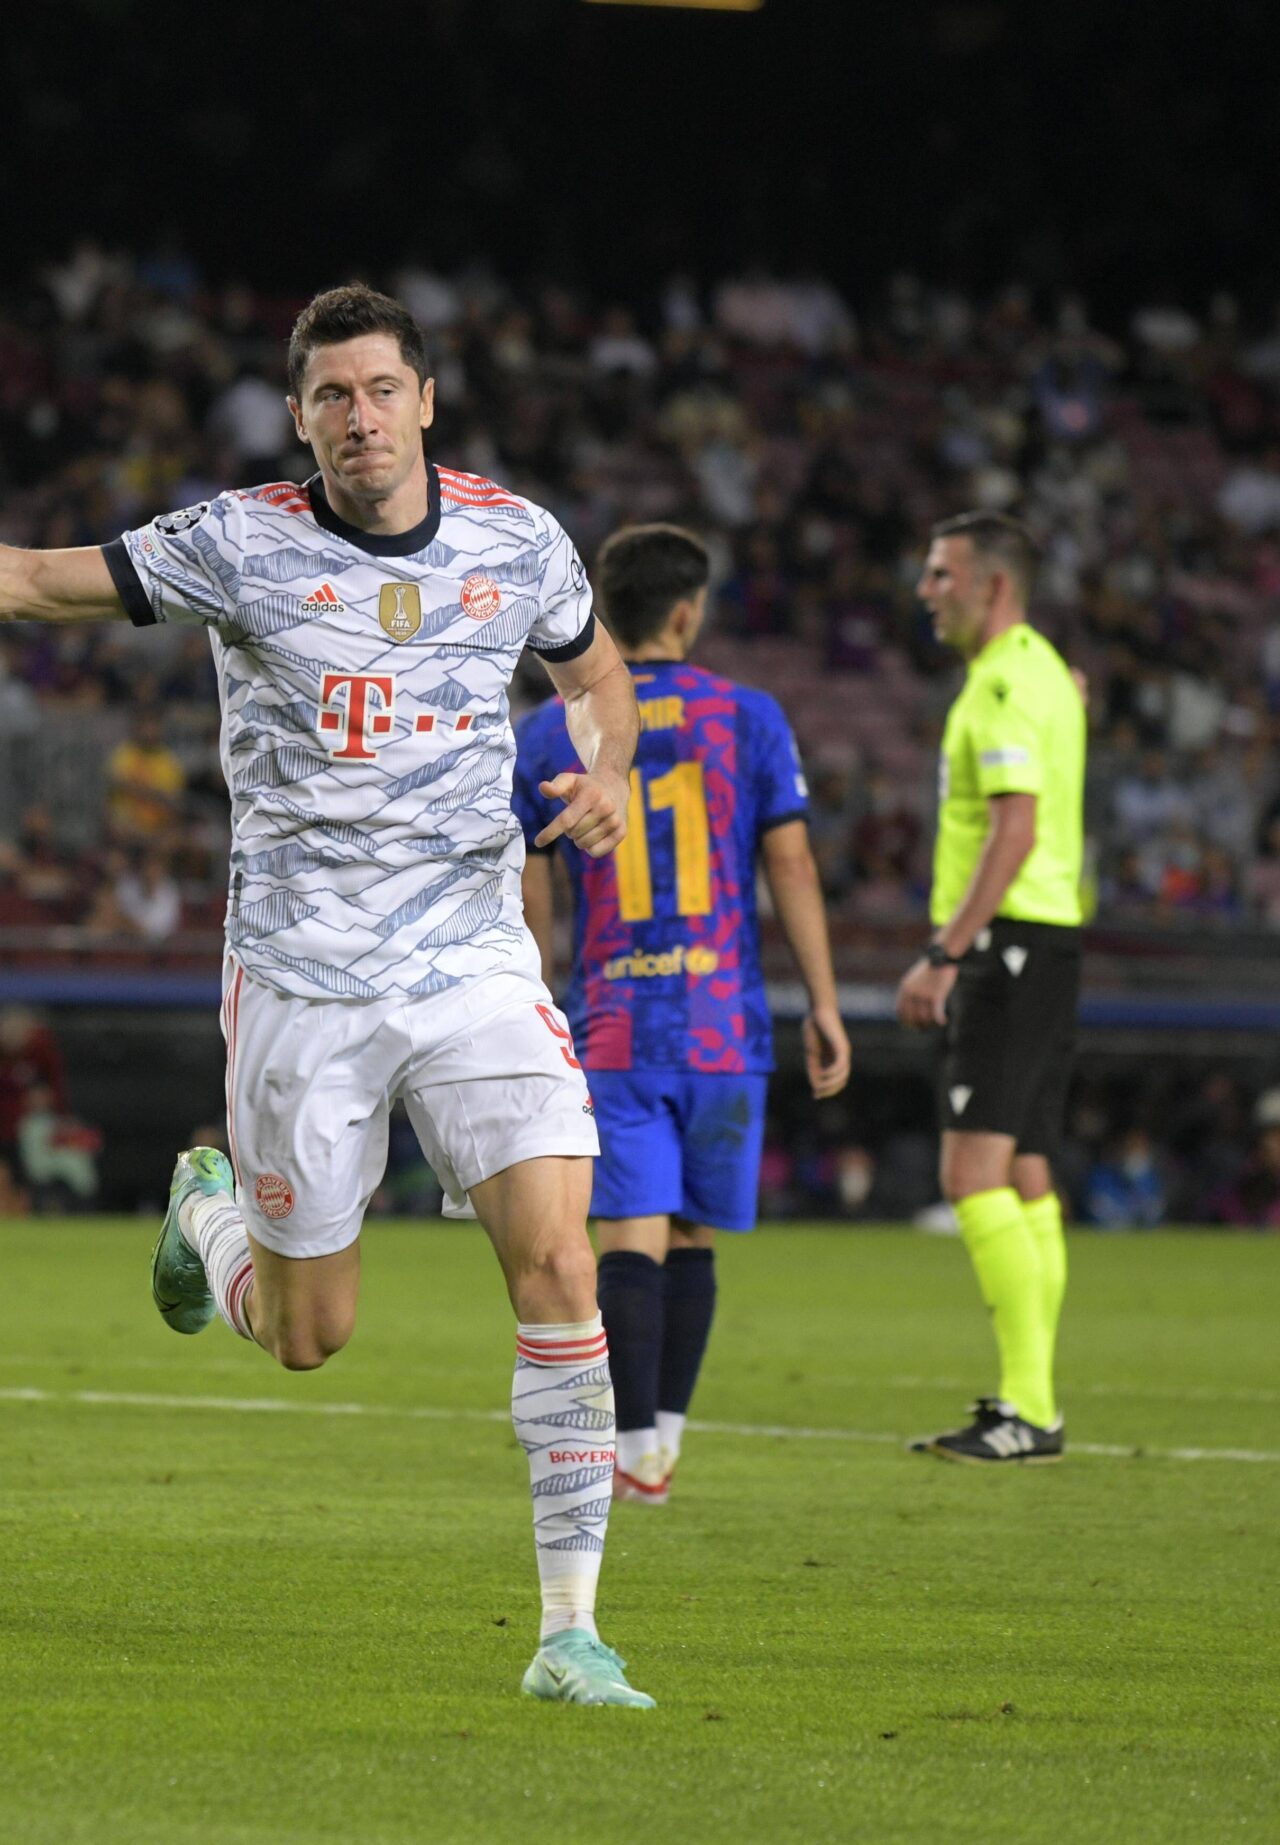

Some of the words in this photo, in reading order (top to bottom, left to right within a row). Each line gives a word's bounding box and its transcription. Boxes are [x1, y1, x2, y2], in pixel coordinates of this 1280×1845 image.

[301, 602, 345, 612] adidas
[391, 620, 411, 628] FIFA
[322, 675, 393, 758] T
[637, 696, 687, 731] MIR
[616, 761, 711, 921] 11
[604, 945, 684, 980] unicef
[549, 1450, 616, 1463] BAYERN
